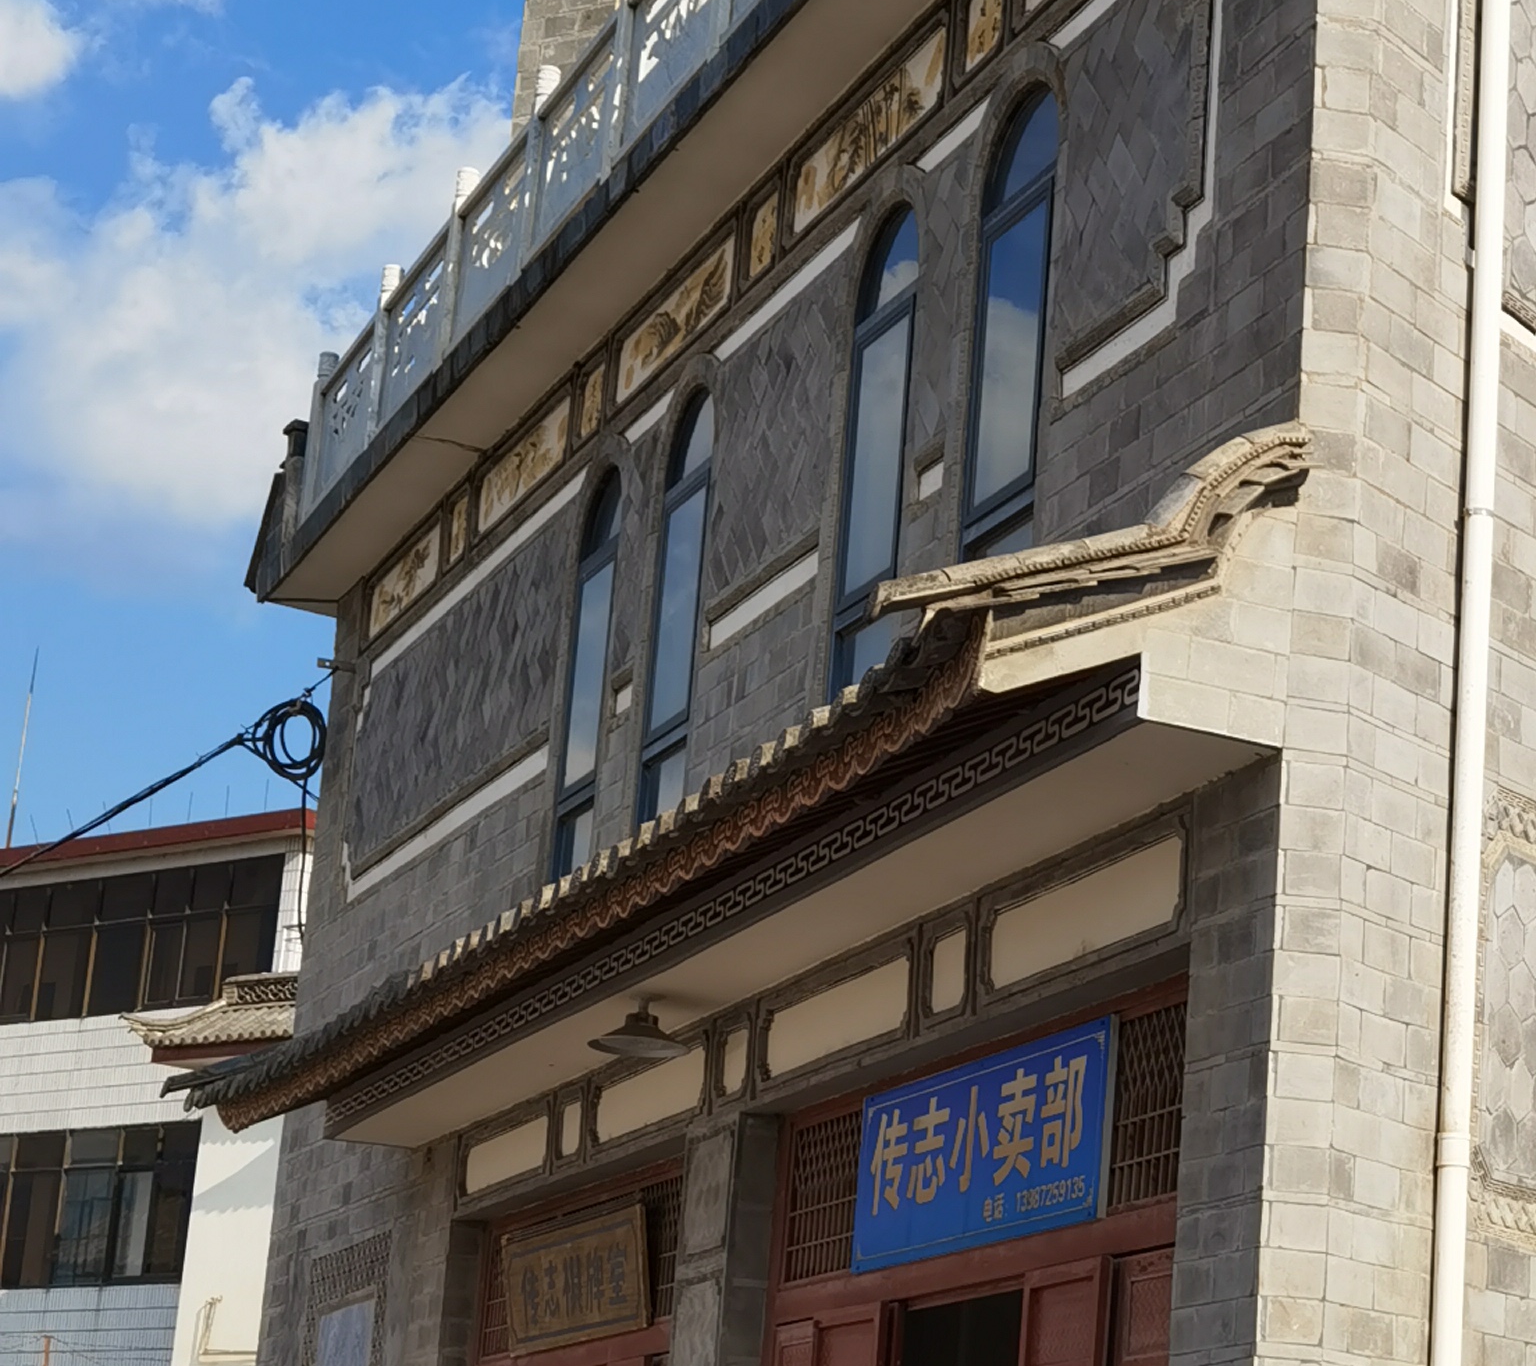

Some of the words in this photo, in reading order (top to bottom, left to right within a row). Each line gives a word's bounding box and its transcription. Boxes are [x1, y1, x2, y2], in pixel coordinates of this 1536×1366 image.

[869, 1053, 1089, 1218] 传志小卖部
[1016, 1175, 1086, 1213] 13987259135
